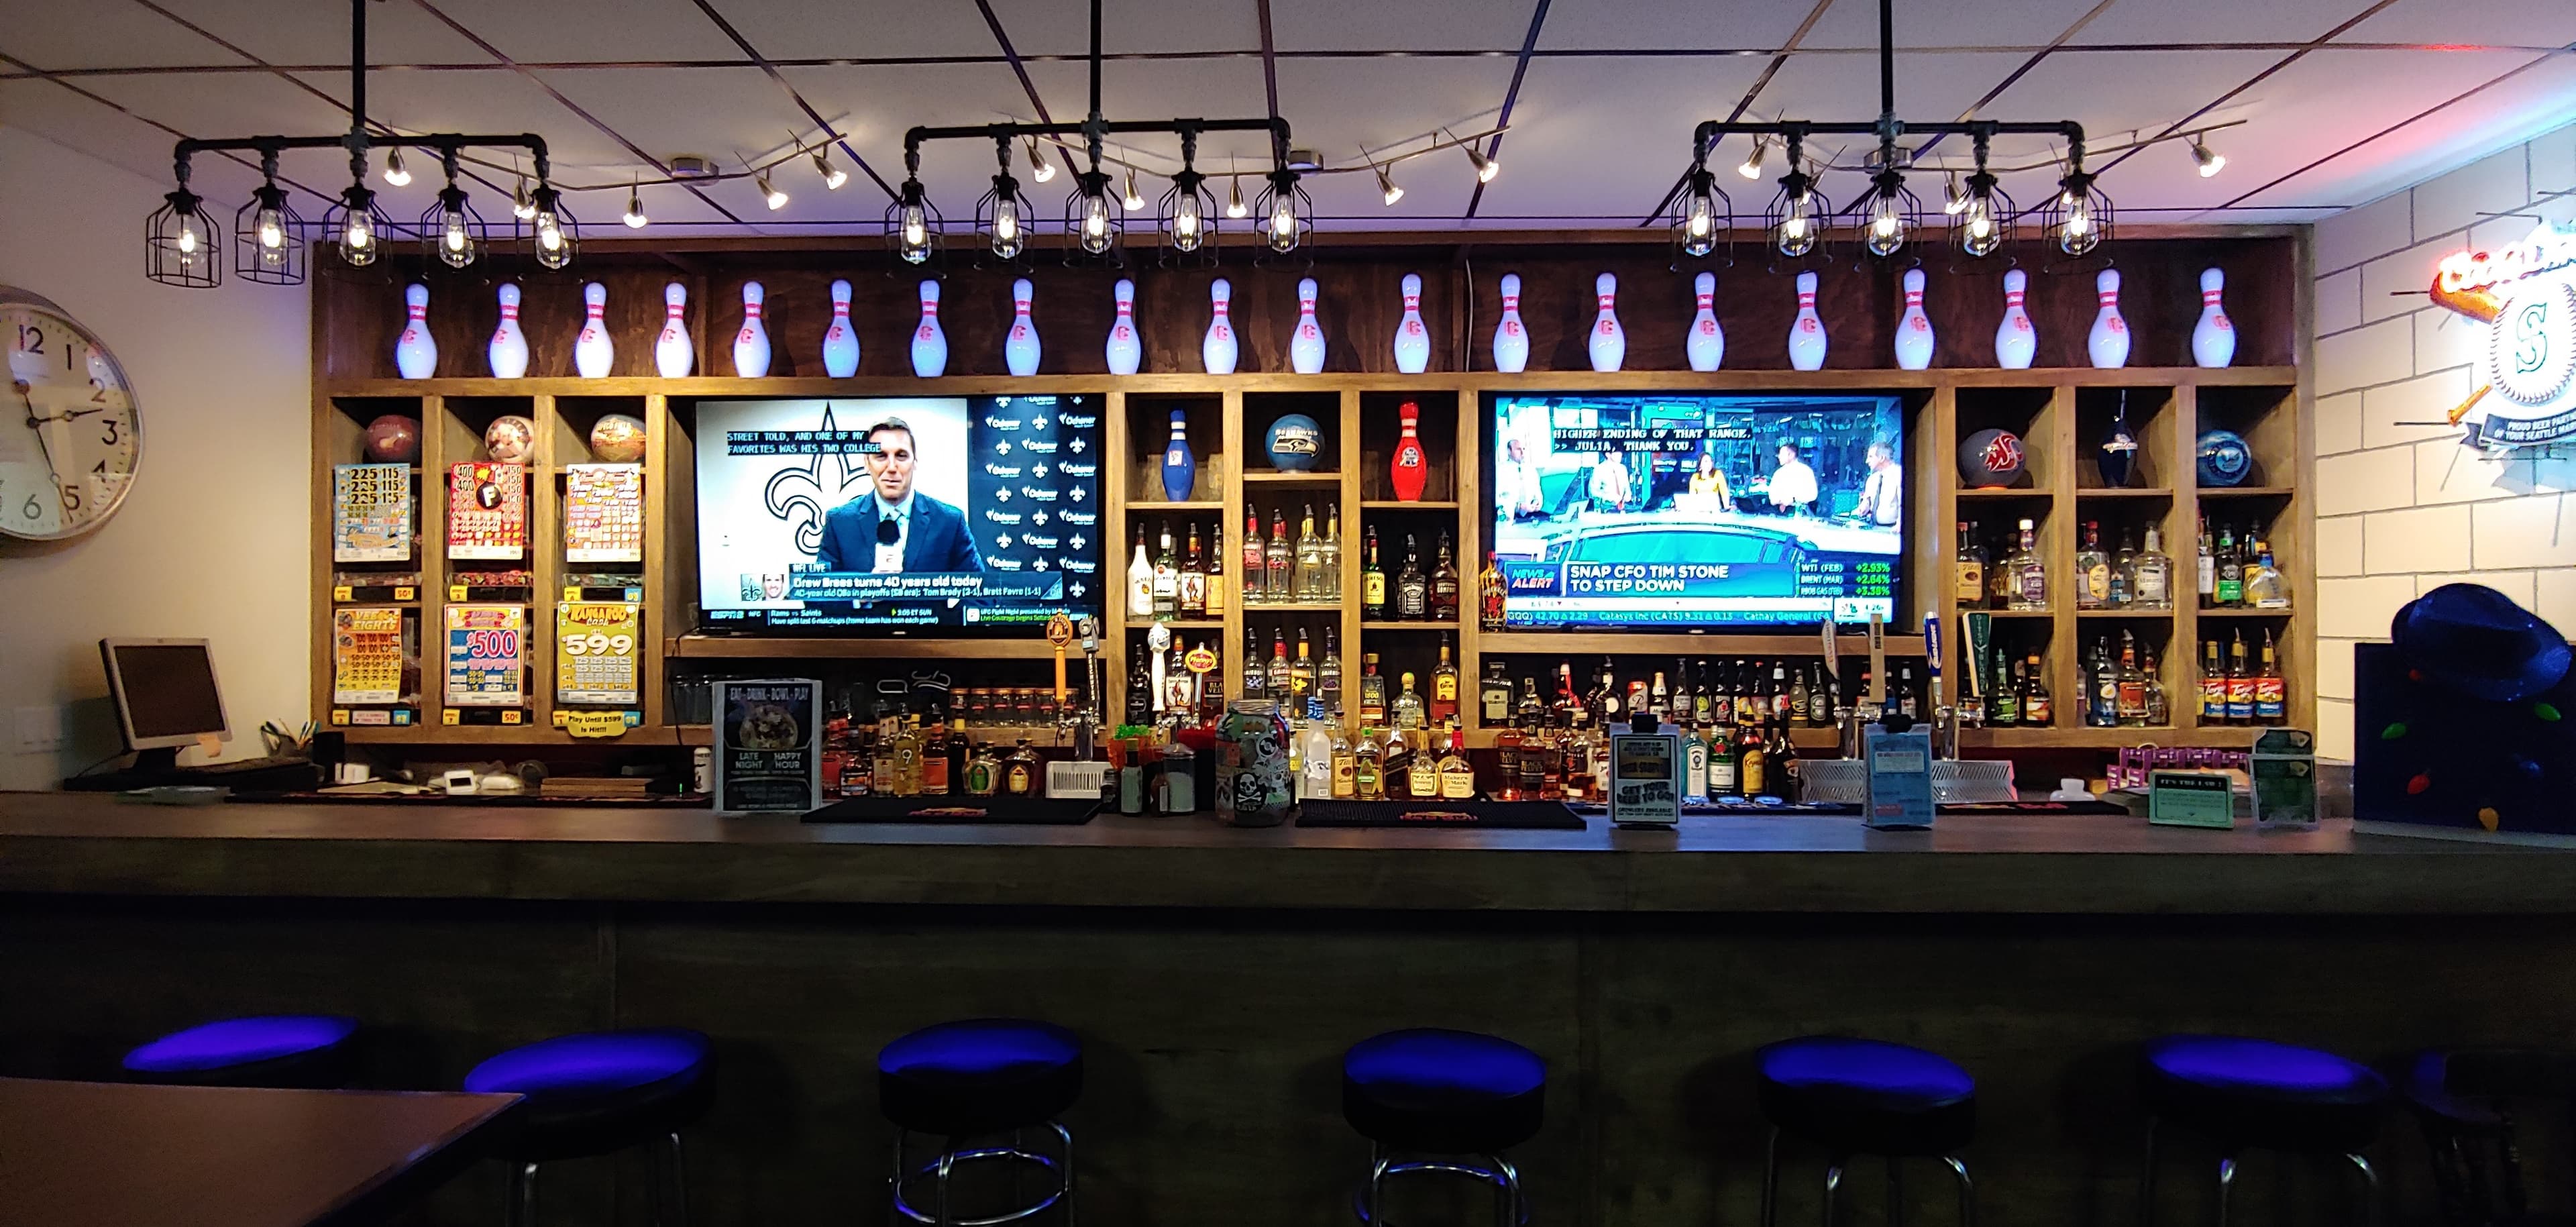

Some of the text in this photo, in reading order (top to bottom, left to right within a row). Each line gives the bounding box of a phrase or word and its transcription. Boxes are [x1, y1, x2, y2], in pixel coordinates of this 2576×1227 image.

[18, 325, 44, 355] 12
[2516, 303, 2548, 374] S
[66, 344, 72, 370] 1
[89, 377, 107, 403] 2
[101, 419, 119, 445] 3
[727, 431, 865, 442] STREET TOLD, AND ONE OF MY
[1553, 429, 1752, 439] HIGHER ENDING OF THAT RANGE,
[728, 443, 881, 454] FAVORITES WAS HIS TWO COLLEGE
[1575, 441, 1695, 452] JULIA, THANK YOU.
[64, 485, 81, 511] 5
[23, 494, 42, 520] 6
[1511, 568, 1544, 578] NEWS
[1570, 565, 1729, 578] SNAP CFO TIM STONE
[1801, 563, 1844, 573] WTI (FEB)
[793, 575, 983, 590] Drew Brees turns 40 years old today
[1511, 578, 1554, 589] ALERT
[1570, 579, 1684, 592] TO STEP DOWN
[824, 589, 836, 597] old
[859, 588, 890, 599] playoffs
[923, 588, 938, 596] Tom
[940, 587, 961, 598] Brady
[983, 586, 1002, 596] Brett
[570, 606, 628, 621] KANGAROO
[352, 619, 398, 631] EIGHTS
[568, 716, 584, 724] Play
[739, 752, 759, 761] LATE
[774, 752, 802, 761] HAPPY
[735, 761, 763, 769] NIGHT
[775, 761, 800, 769] HOUR
